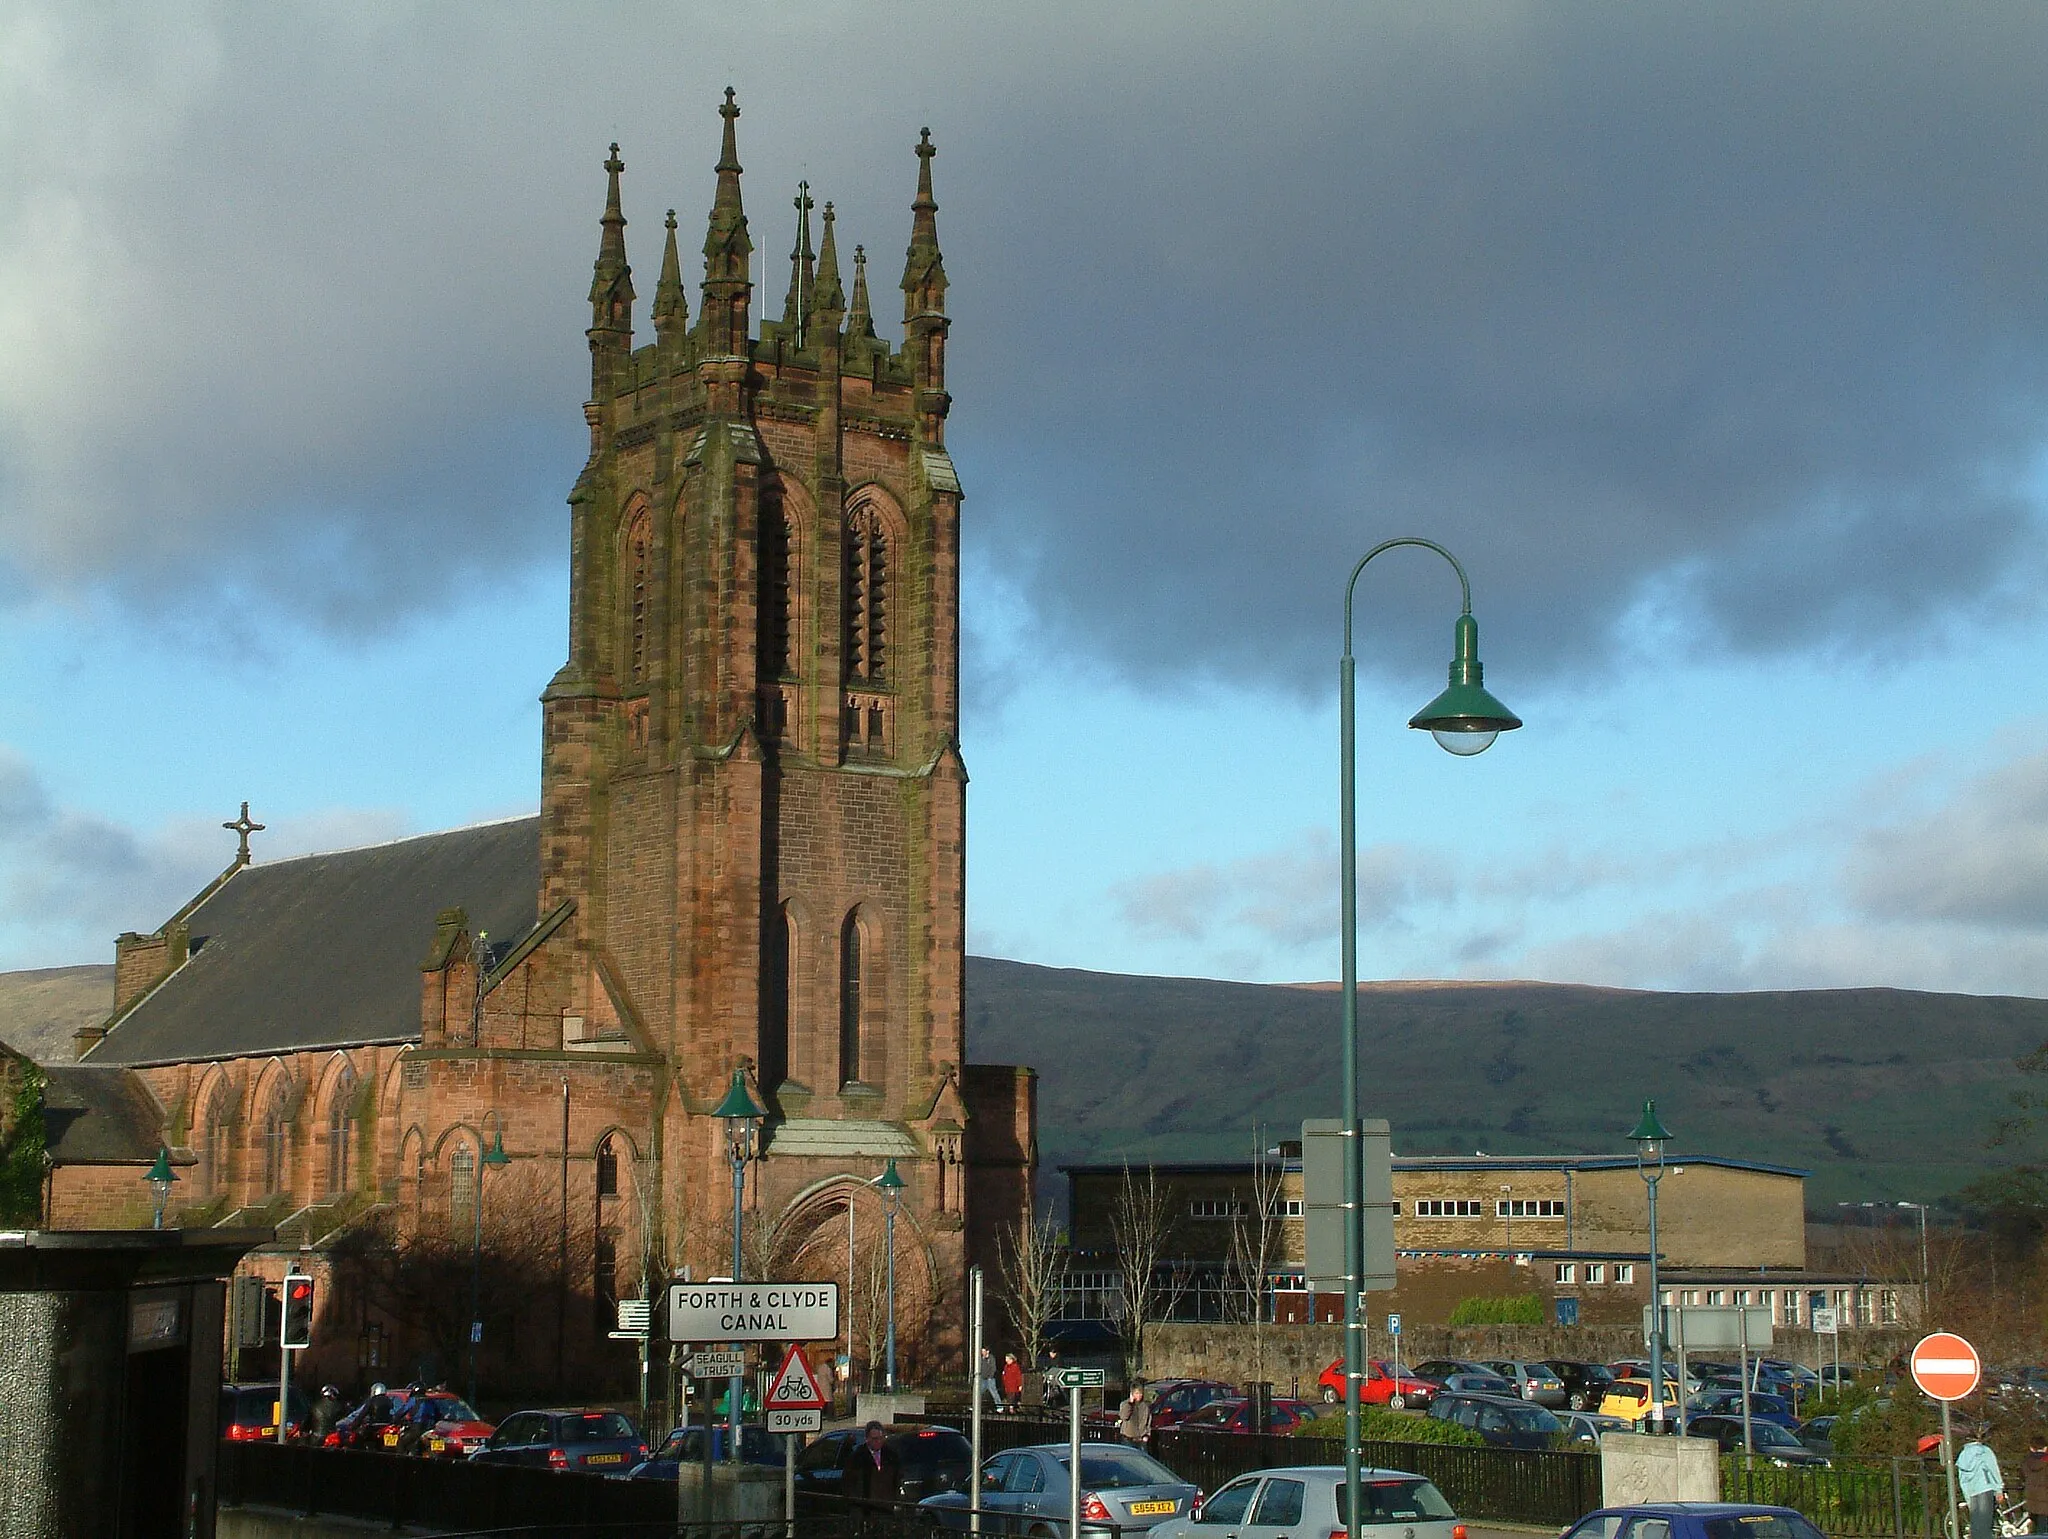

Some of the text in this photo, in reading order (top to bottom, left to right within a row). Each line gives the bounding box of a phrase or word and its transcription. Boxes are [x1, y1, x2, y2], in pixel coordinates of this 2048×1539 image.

[678, 1291, 829, 1309] FORTH & CLYDE
[720, 1314, 788, 1331] CANAL
[1391, 1317, 1399, 1333] P
[696, 1353, 742, 1364] SEAGULL
[704, 1365, 736, 1376] TRUST
[775, 1414, 813, 1427] 30 yds
